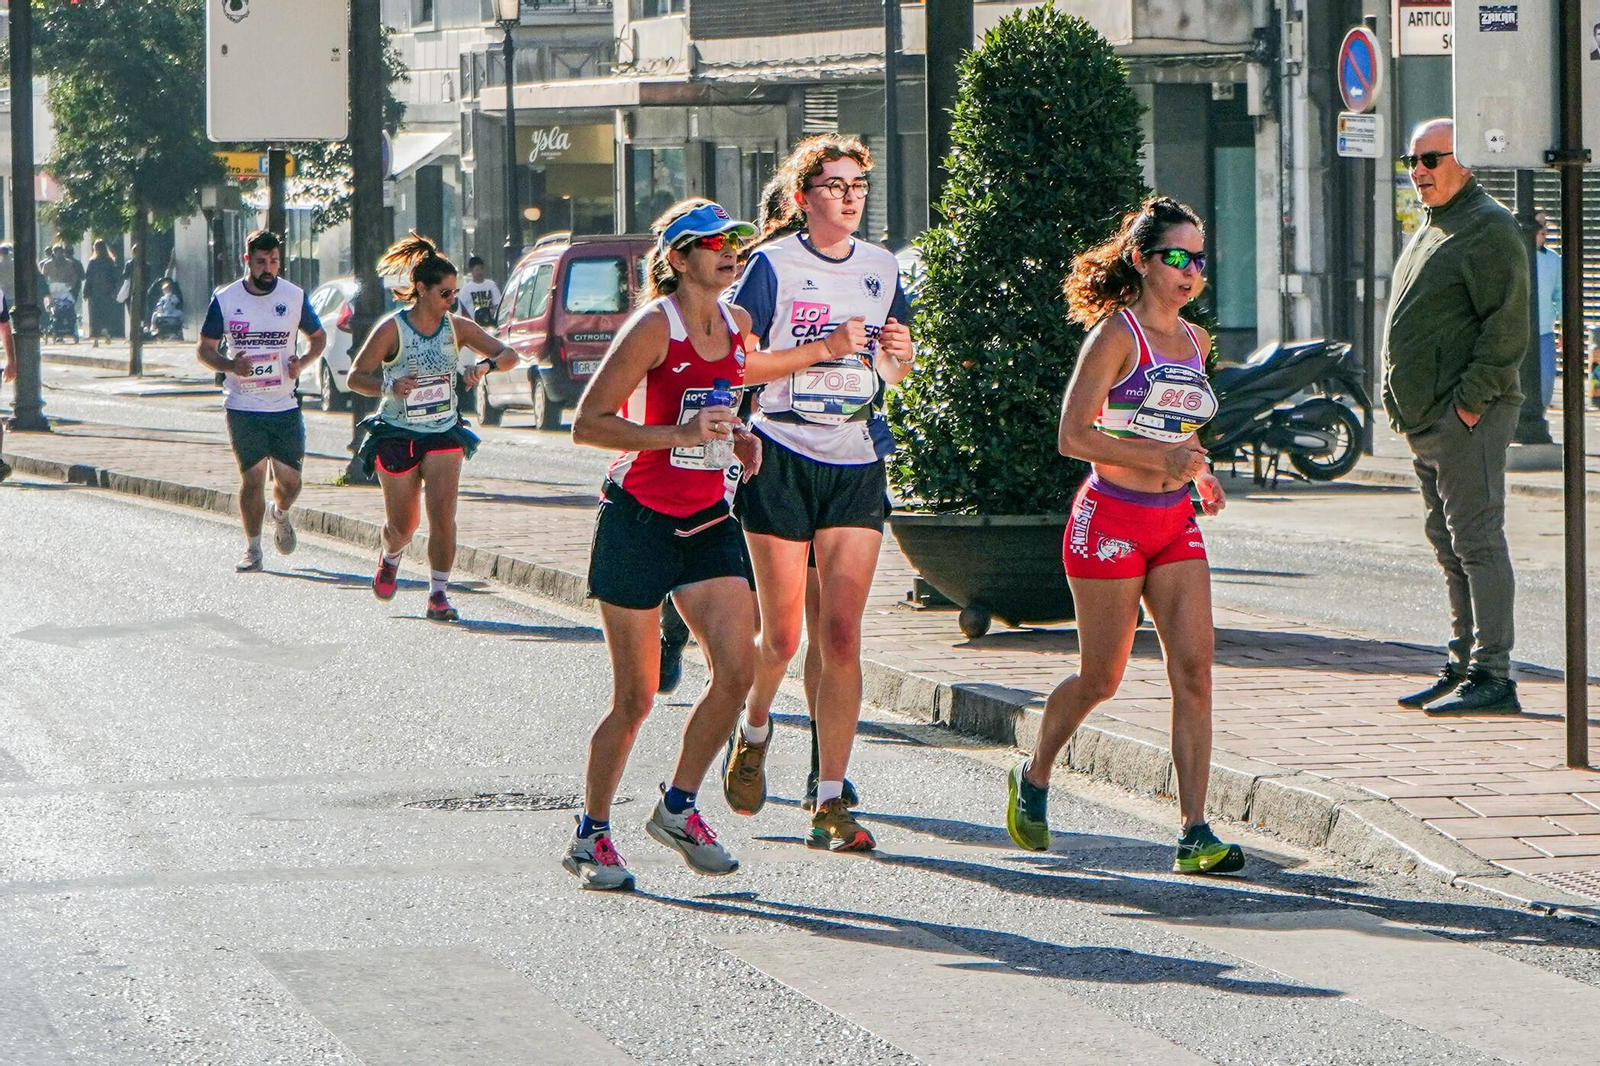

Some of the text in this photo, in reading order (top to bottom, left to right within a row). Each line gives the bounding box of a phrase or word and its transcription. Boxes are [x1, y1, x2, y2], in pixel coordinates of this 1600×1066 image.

[1407, 11, 1452, 27] ARTICU
[1442, 33, 1452, 49] S
[529, 126, 571, 163] ysla
[231, 331, 290, 340] CARRERA
[806, 371, 861, 393] 702
[414, 387, 444, 402] 464
[1157, 388, 1203, 411] 916
